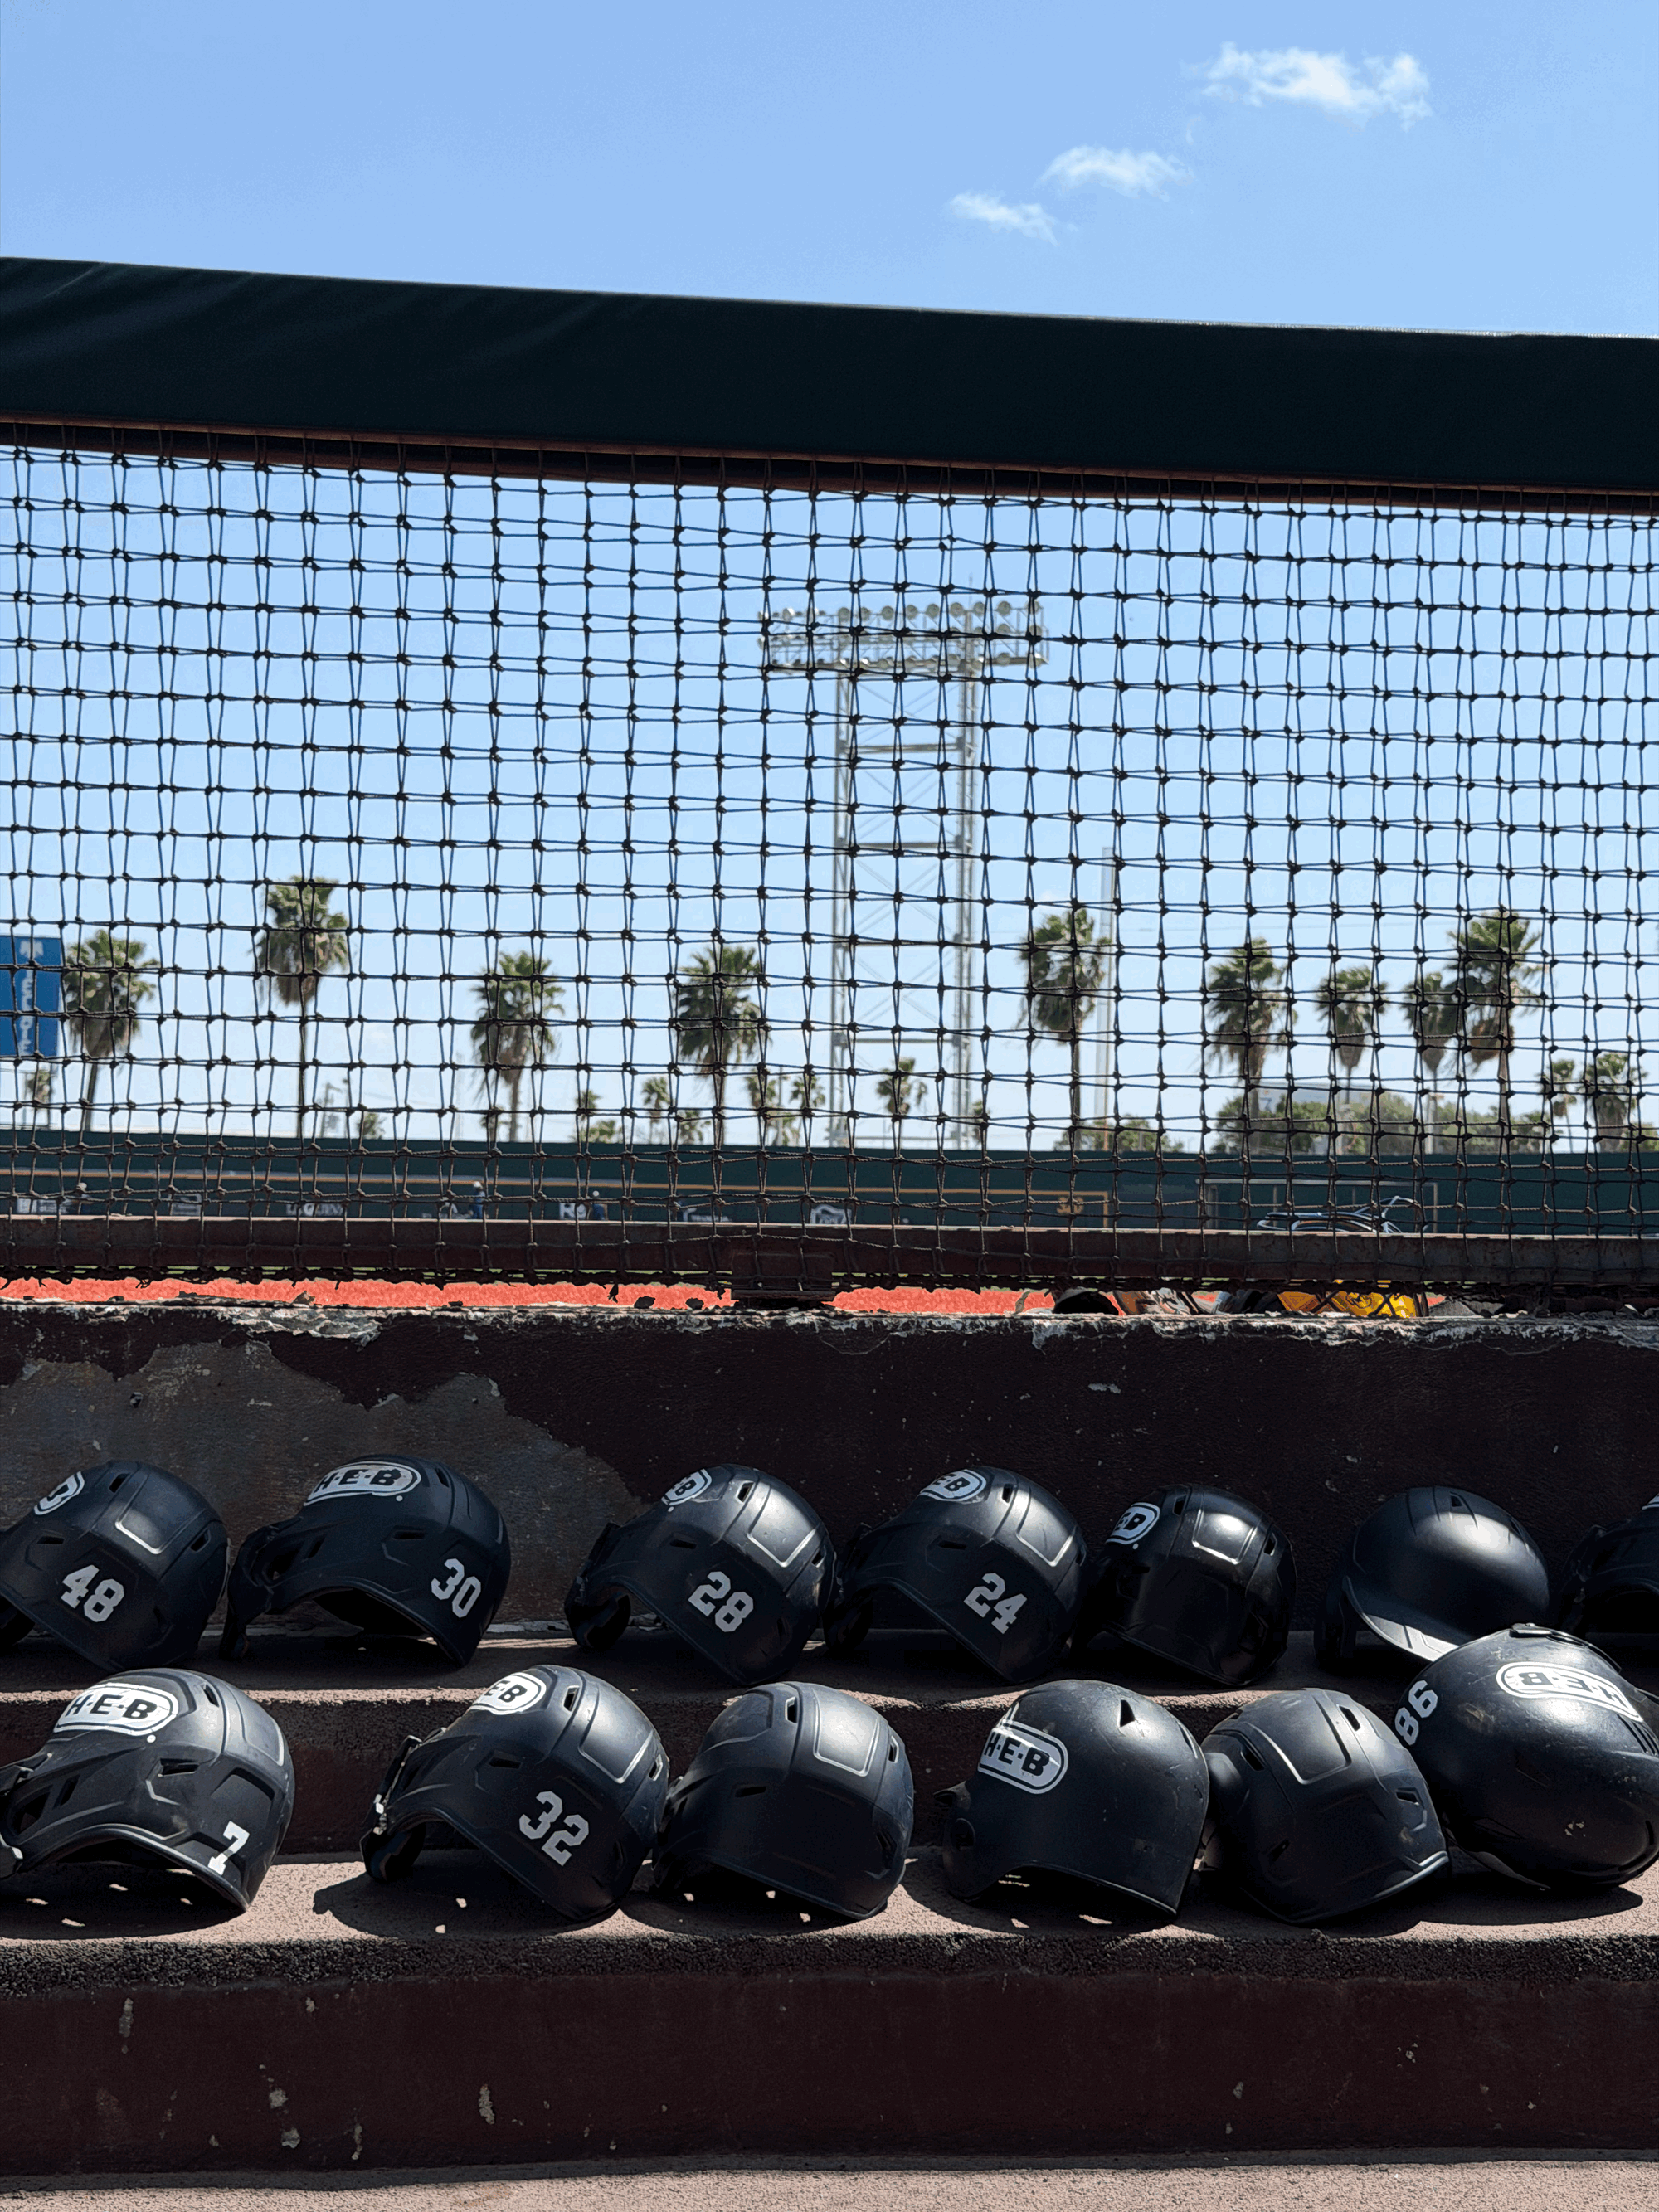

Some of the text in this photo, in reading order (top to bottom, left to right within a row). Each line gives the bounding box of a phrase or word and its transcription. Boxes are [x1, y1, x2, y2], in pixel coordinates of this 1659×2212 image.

[61, 1564, 124, 1622] 48
[431, 1558, 482, 1618] 30
[688, 1571, 754, 1632] 28
[963, 1573, 1028, 1634] 24
[208, 1821, 249, 1874] 7
[518, 1791, 589, 1866] 32
